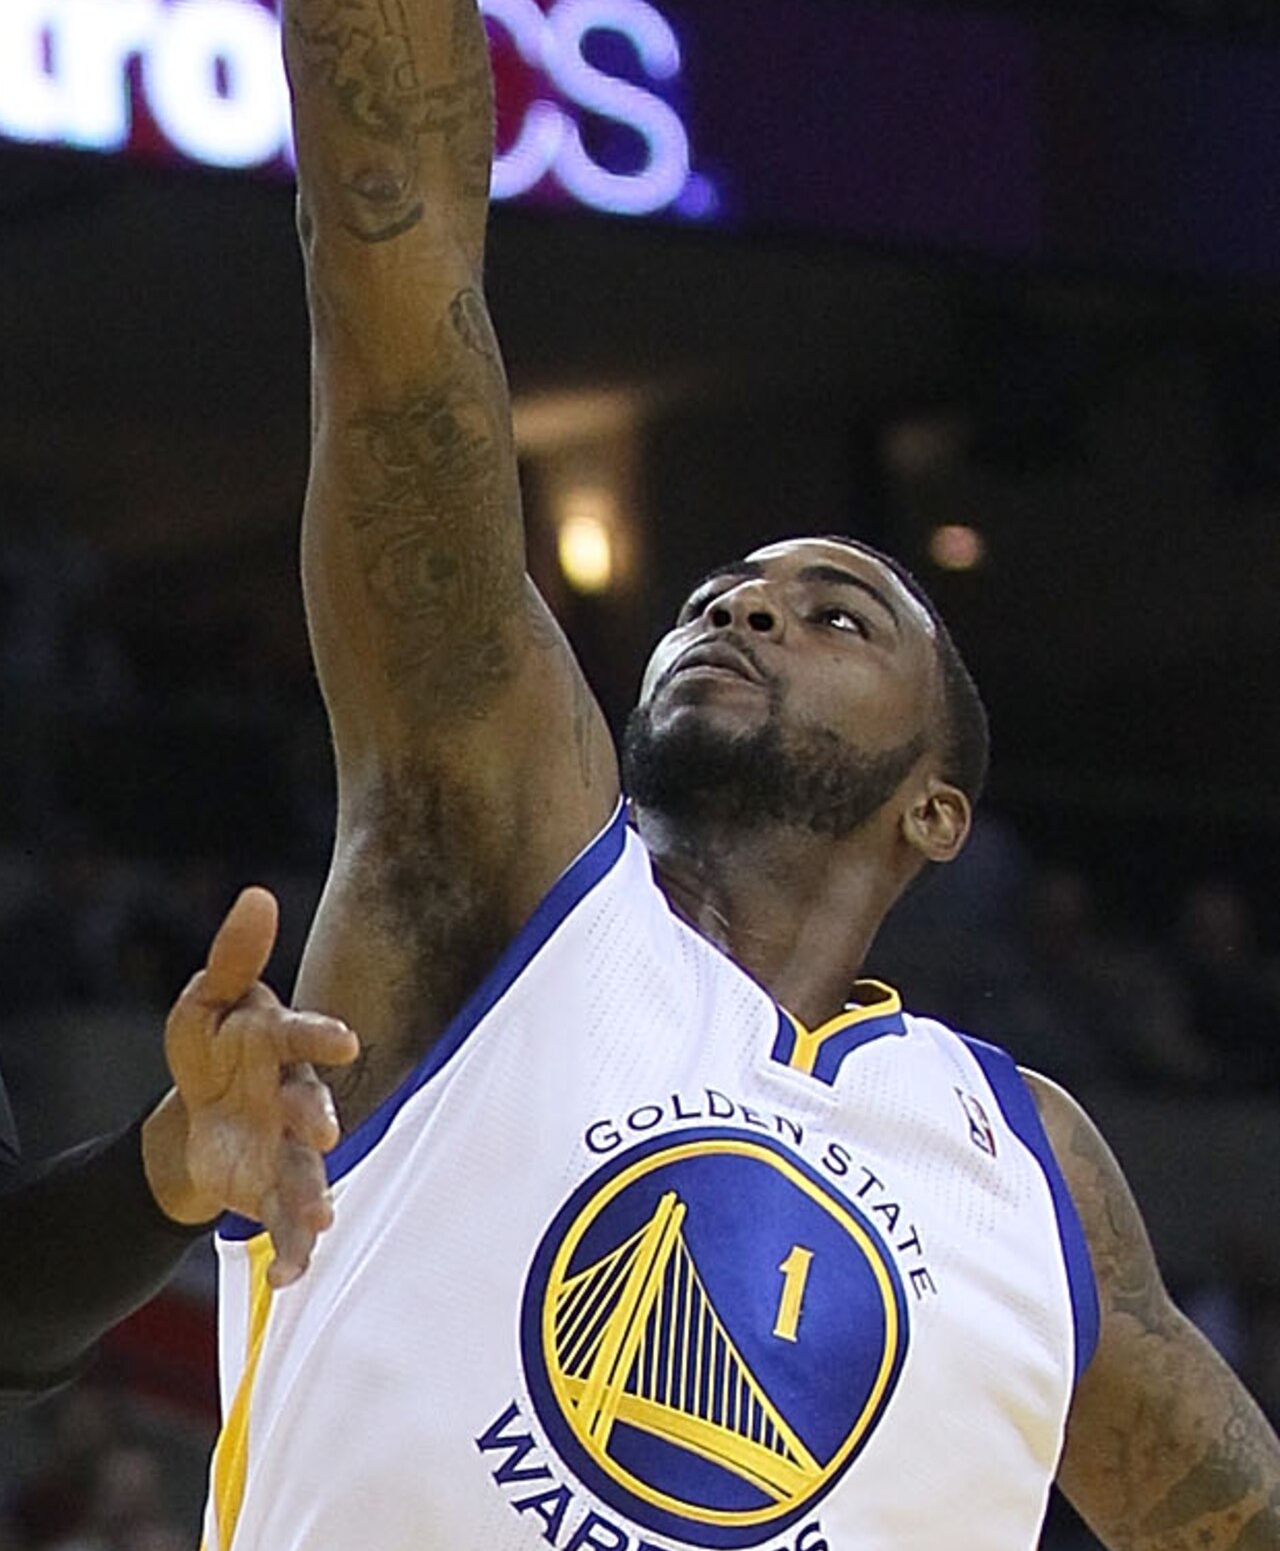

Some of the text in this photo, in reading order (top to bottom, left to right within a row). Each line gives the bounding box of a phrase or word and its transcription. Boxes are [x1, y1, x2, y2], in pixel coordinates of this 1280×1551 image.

[584, 1088, 938, 1302] GOLDEN STATE
[773, 1245, 815, 1343] 1
